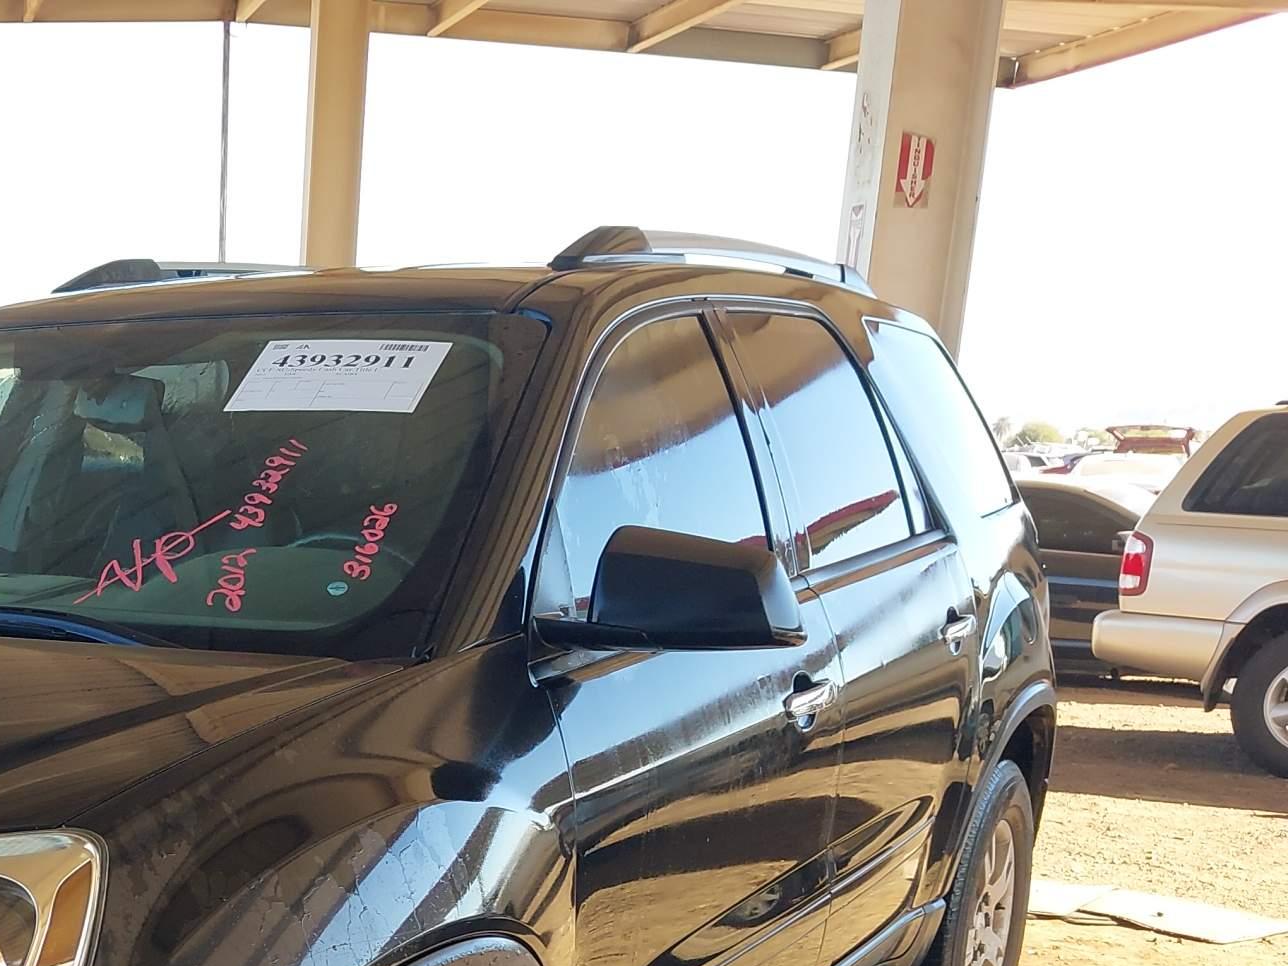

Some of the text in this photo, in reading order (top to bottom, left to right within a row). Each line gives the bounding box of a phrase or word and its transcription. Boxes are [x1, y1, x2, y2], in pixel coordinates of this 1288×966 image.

[272, 354, 415, 369] 43932911
[229, 439, 308, 530] 43932911
[343, 502, 398, 580] 316026
[206, 547, 257, 612] 2012
